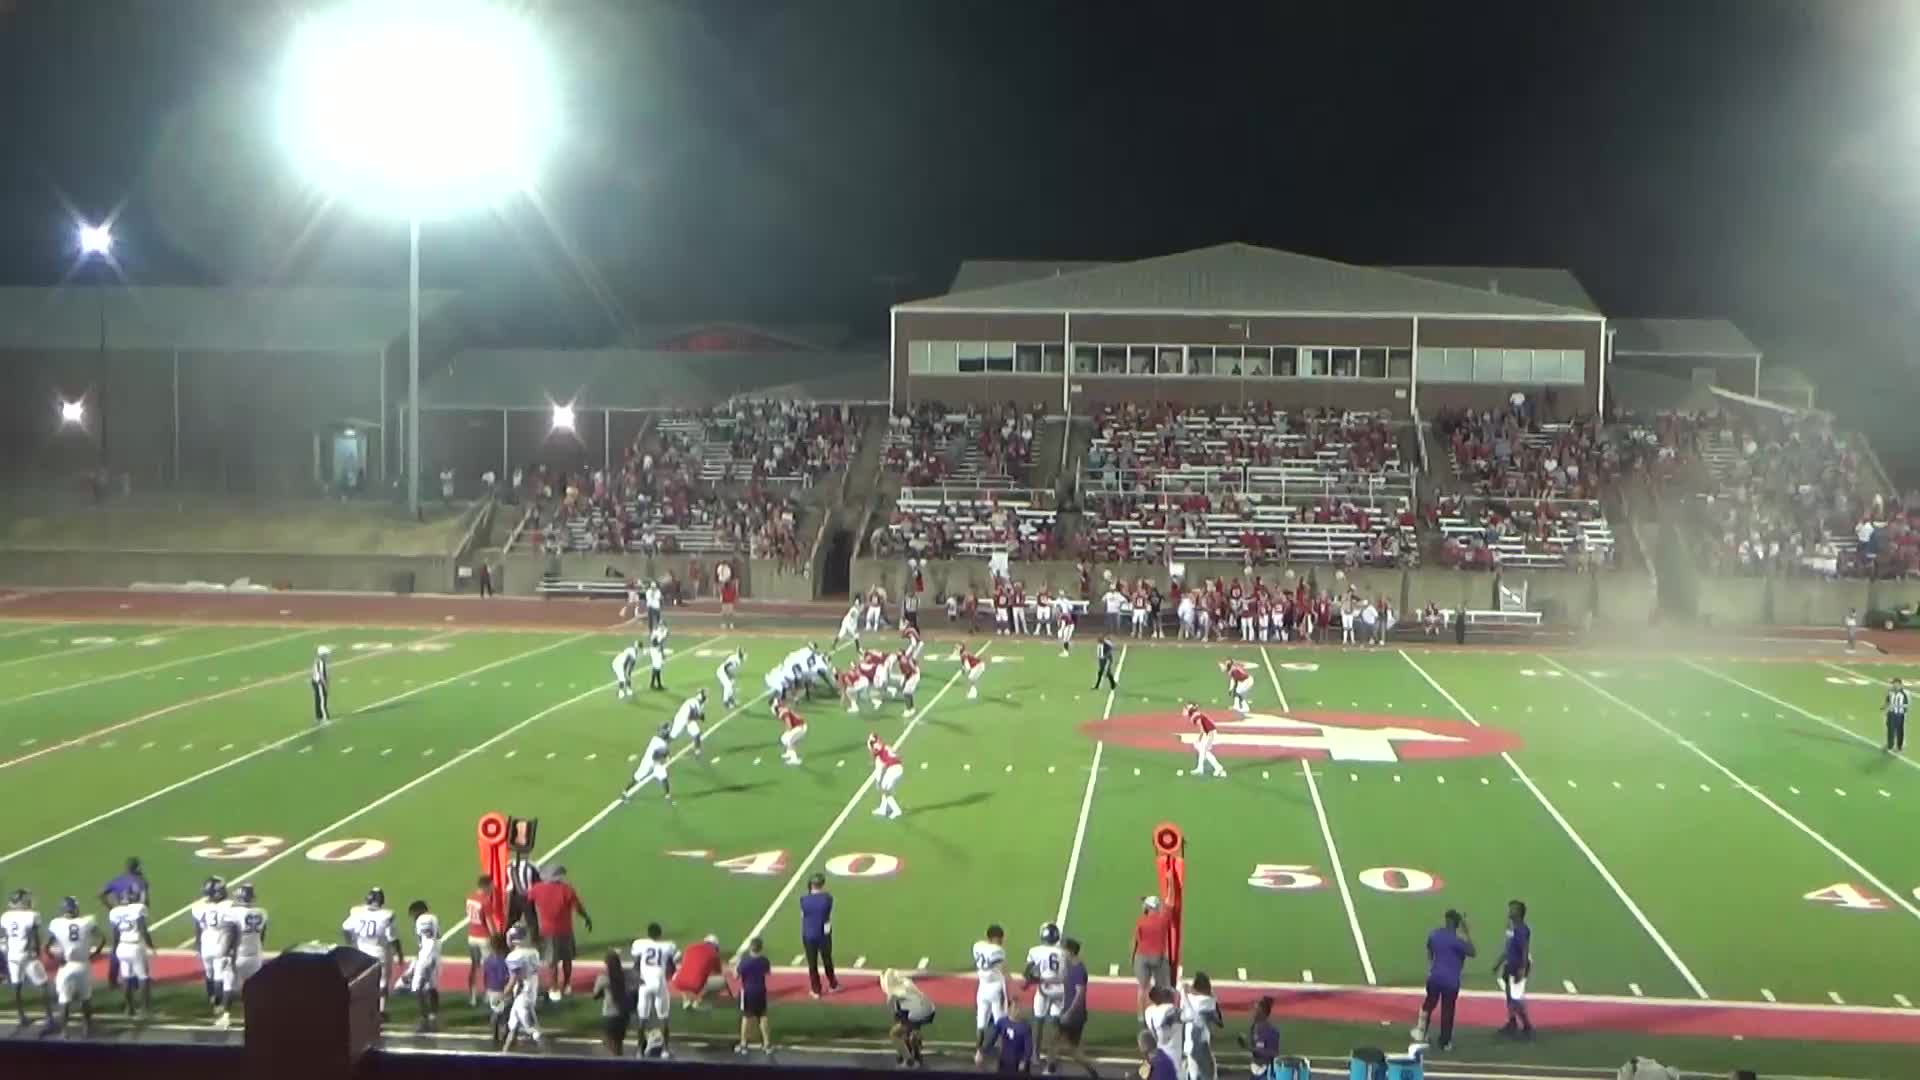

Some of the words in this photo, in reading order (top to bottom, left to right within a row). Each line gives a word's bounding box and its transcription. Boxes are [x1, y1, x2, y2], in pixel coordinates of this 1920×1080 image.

[68, 923, 79, 942] 8
[360, 919, 377, 937] 70
[645, 947, 662, 966] 21
